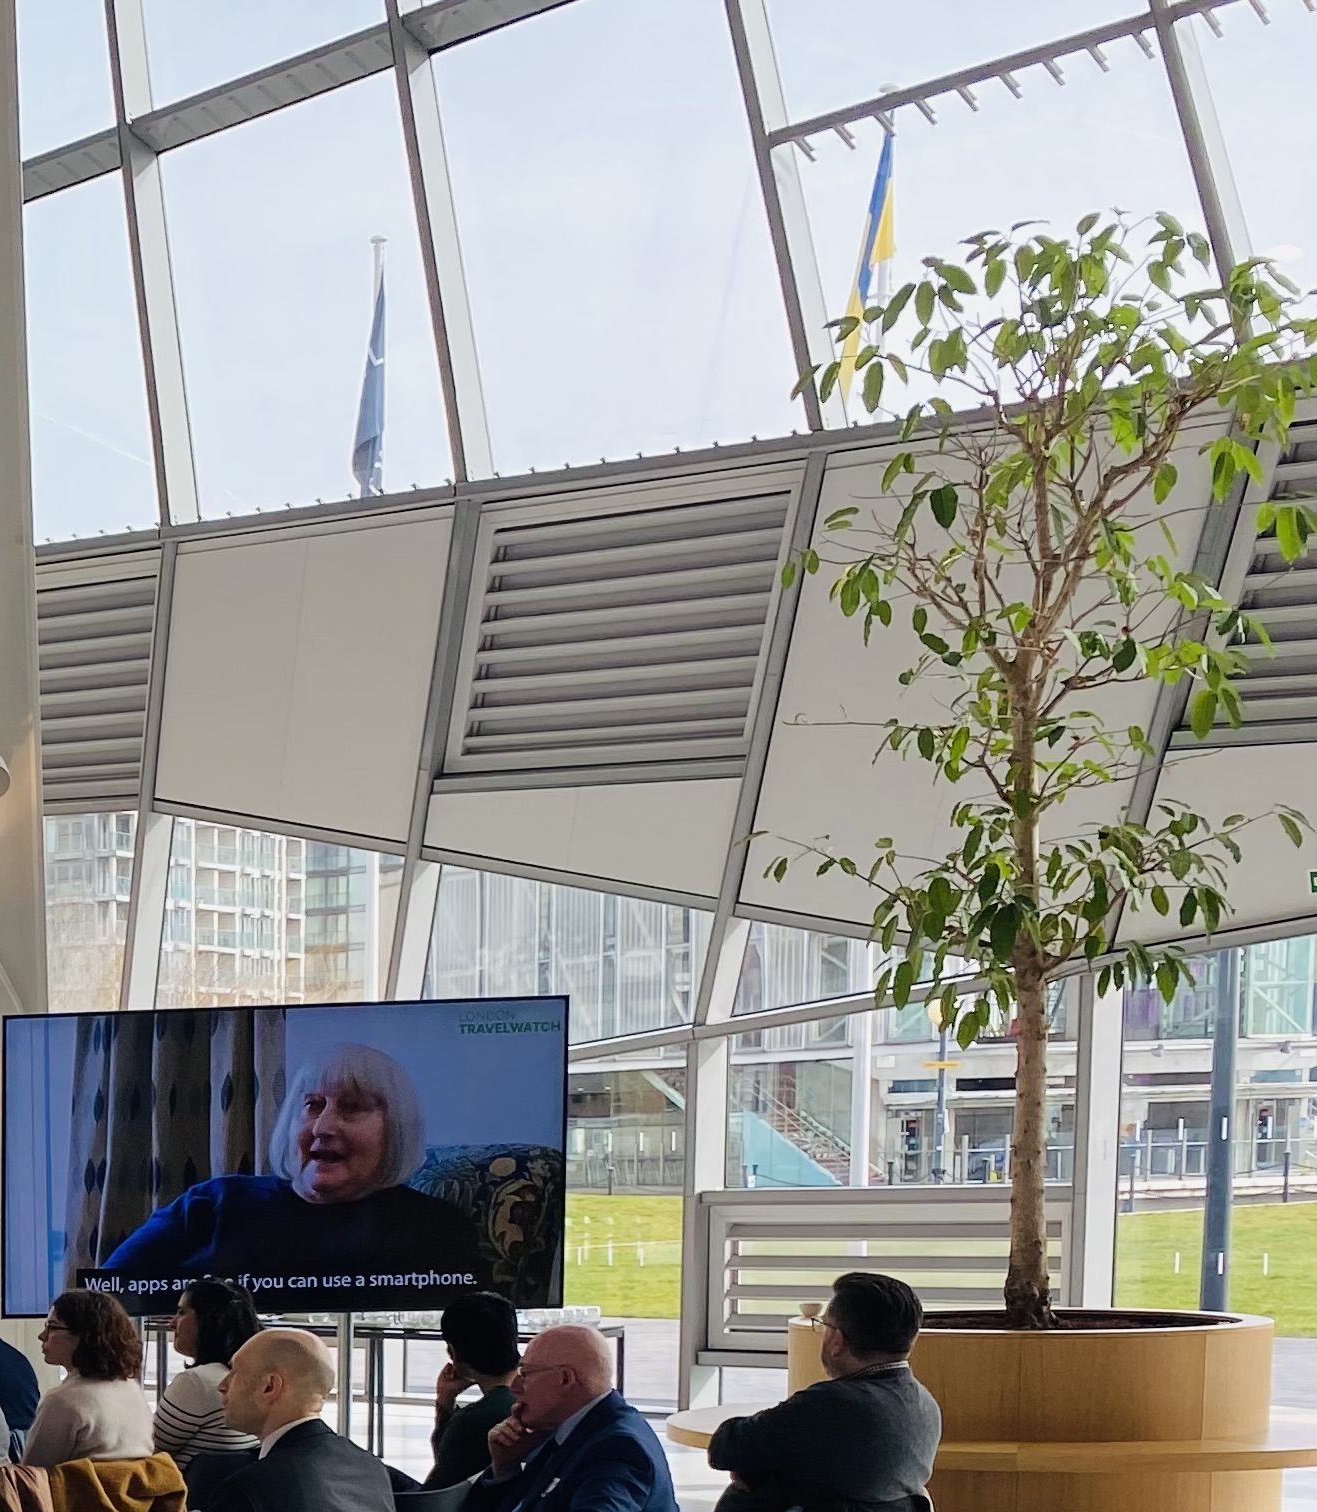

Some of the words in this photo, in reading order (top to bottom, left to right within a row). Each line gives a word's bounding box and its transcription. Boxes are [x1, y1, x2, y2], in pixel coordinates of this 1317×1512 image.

[458, 1009, 516, 1022] LONDON
[459, 1020, 561, 1034] TRAVELWATCH
[84, 1276, 125, 1294] Well,
[127, 1278, 169, 1295] apps
[237, 1273, 251, 1289] if
[252, 1276, 284, 1293] you
[287, 1275, 318, 1288] can
[322, 1275, 352, 1287] use
[355, 1274, 366, 1287] a
[369, 1269, 478, 1289] smartphone.
